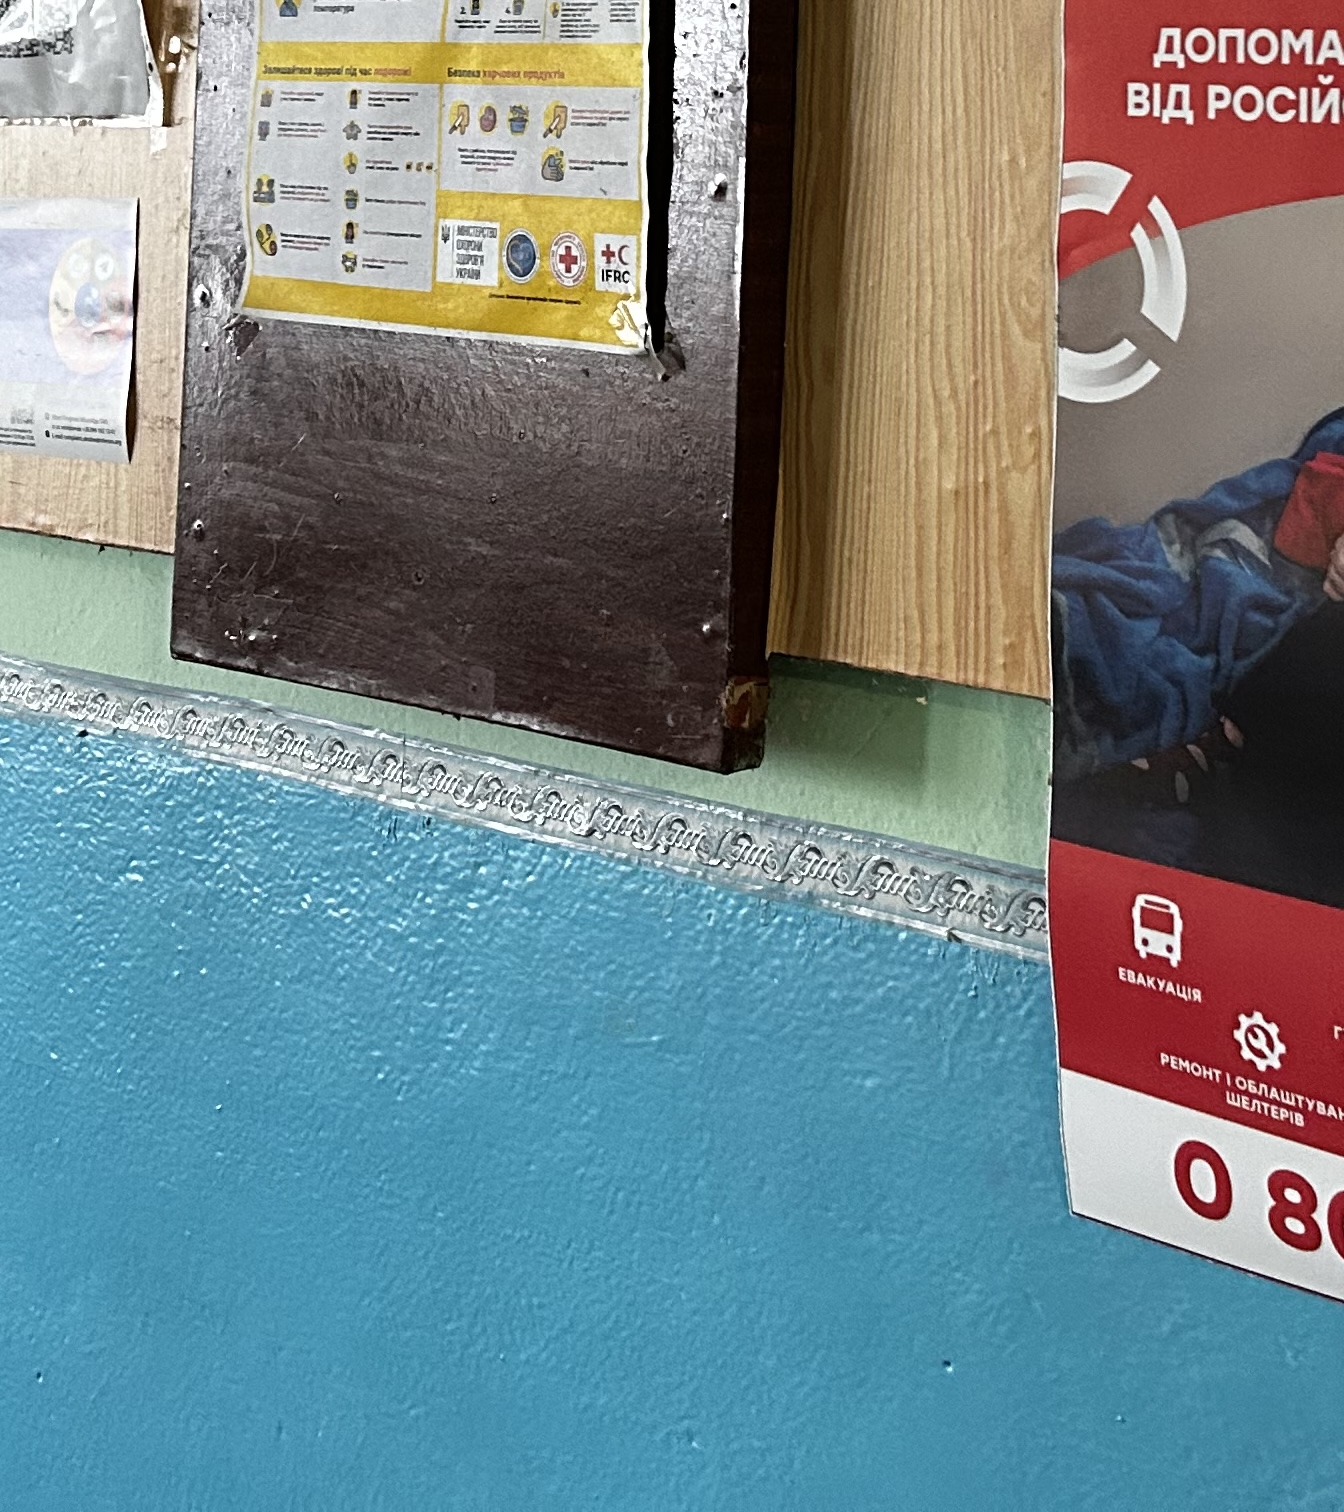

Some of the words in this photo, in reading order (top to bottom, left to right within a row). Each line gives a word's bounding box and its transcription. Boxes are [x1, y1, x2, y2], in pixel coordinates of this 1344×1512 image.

[1125, 83, 1194, 127] ВІД
[600, 268, 631, 285] IFRC
[1117, 966, 1202, 1003] ЕВАКУАЦІЯ
[1159, 1051, 1223, 1084] РЕМОНТ
[1224, 1091, 1305, 1128] ШЕЛТЕРІВ
[1173, 1139, 1233, 1221] 0
